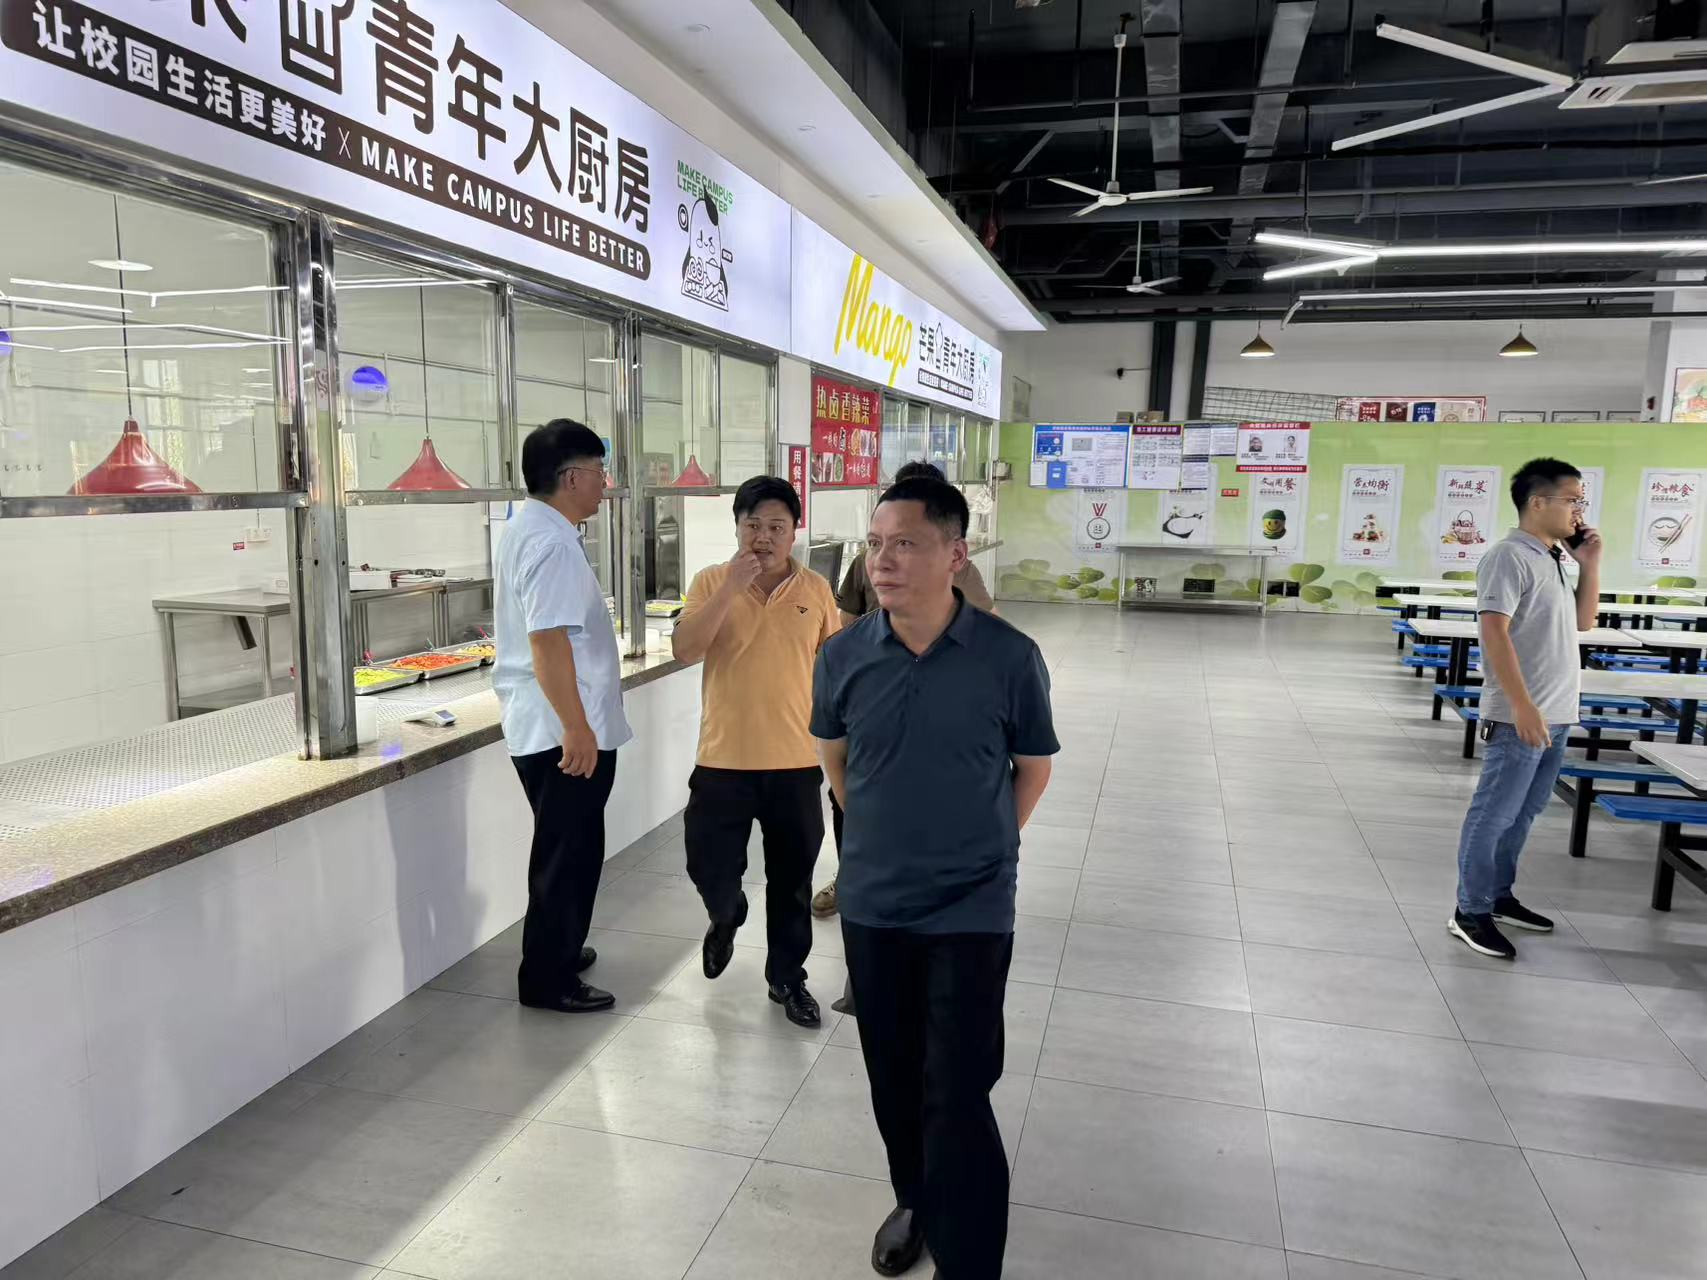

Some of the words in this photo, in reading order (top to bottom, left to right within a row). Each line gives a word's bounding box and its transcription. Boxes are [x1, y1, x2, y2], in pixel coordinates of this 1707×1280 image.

[32, 0, 327, 151] 让校园生活更美好
[361, 136, 434, 192] MAKE
[447, 173, 534, 229] CAMPUS
[543, 211, 580, 248] LIFE
[589, 230, 644, 273] BETTER
[677, 159, 701, 186] MAKE
[702, 175, 734, 205] CAMPUS
[677, 174, 698, 198] LIFE
[834, 254, 912, 388] Mango
